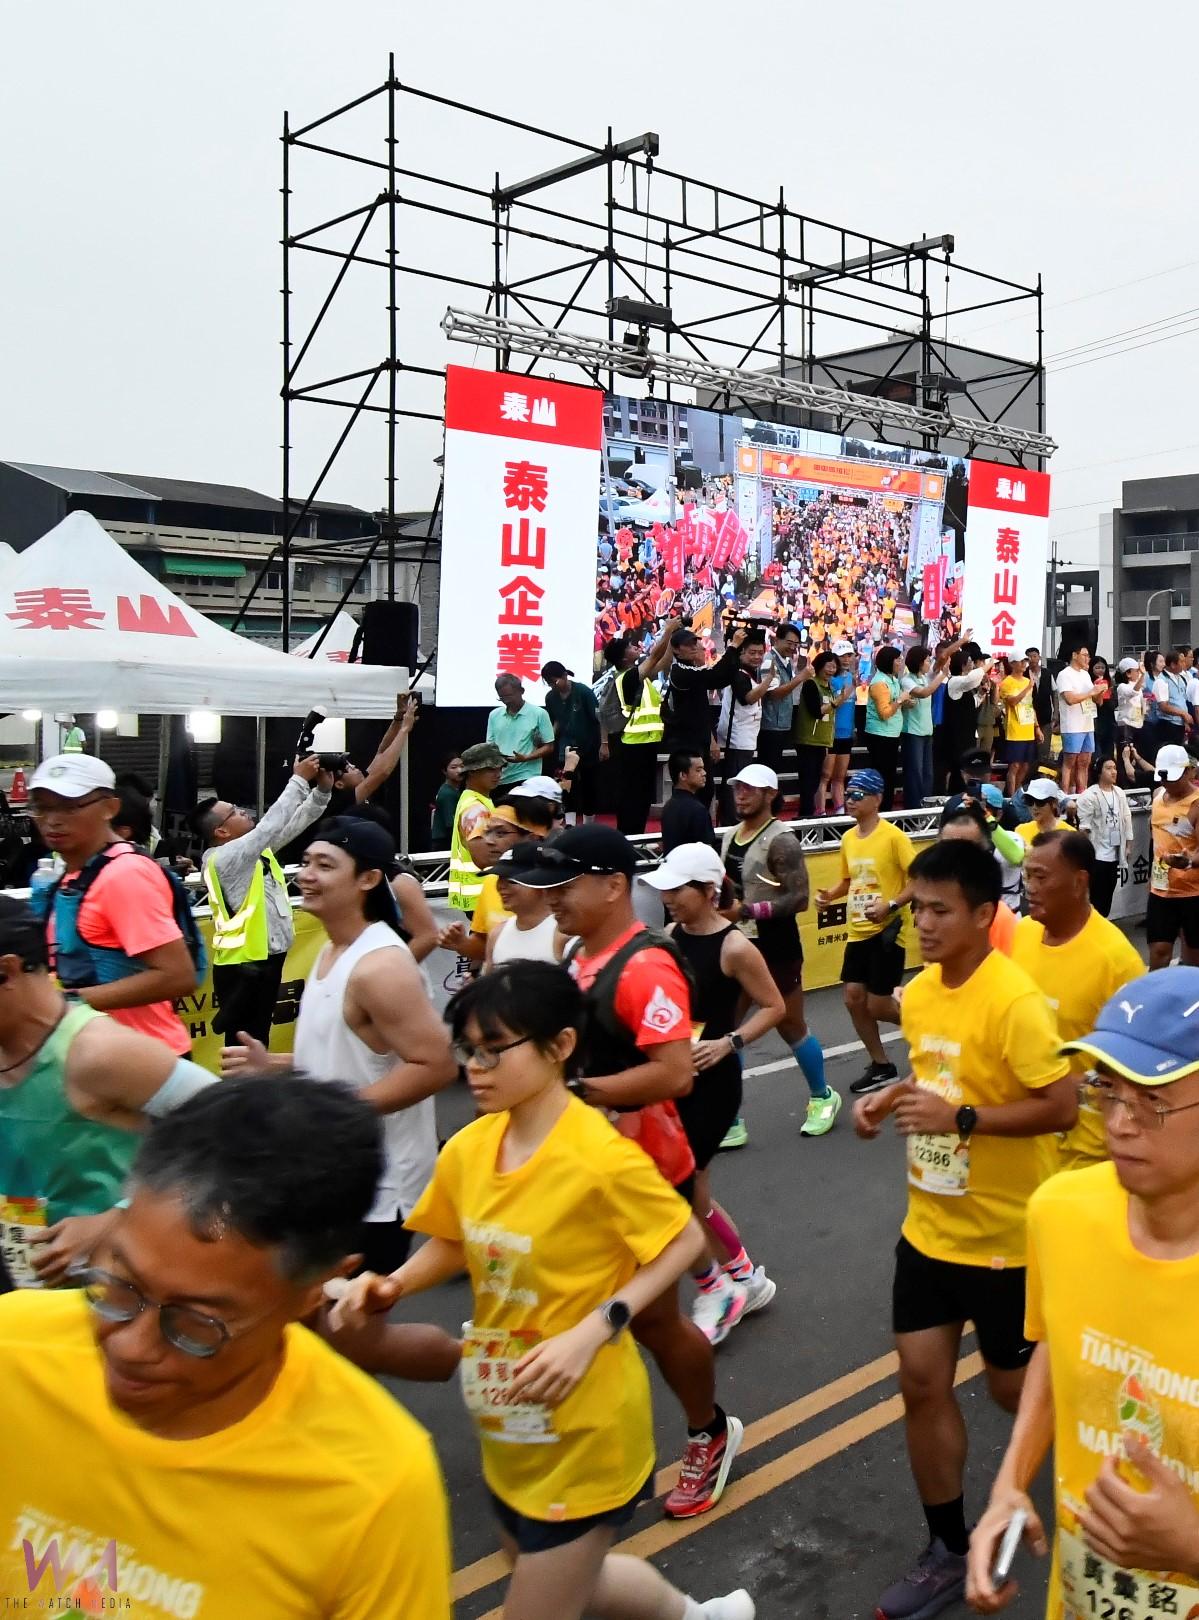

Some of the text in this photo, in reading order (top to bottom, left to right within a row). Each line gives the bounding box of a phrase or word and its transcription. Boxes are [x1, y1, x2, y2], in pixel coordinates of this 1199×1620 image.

[499, 391, 557, 427] 泰山
[496, 460, 549, 683] 泰山企業
[991, 527, 1019, 662] 泰山企
